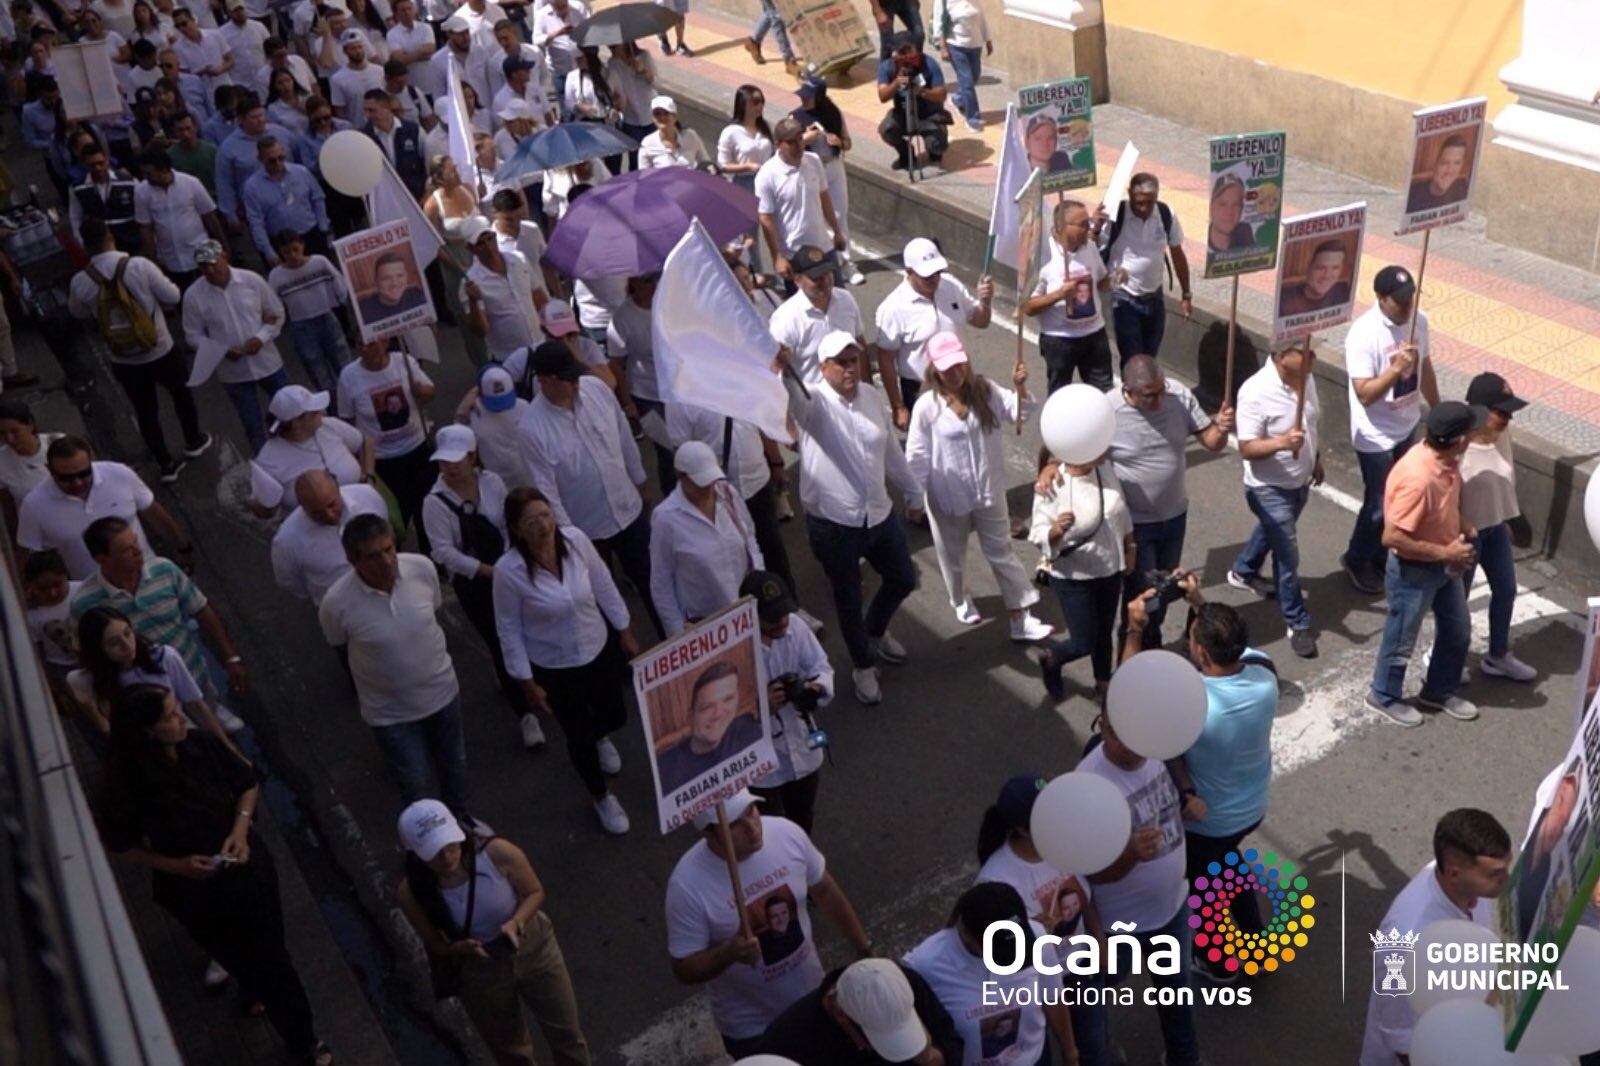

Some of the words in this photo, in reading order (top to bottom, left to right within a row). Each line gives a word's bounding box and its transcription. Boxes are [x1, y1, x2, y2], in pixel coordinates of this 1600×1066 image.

[731, 607, 754, 637] YA!
[666, 814, 680, 830] LO
[735, 774, 749, 795] EN
[750, 760, 775, 784] CASA
[675, 772, 719, 808] FABIAN
[721, 750, 758, 781] ARIAS
